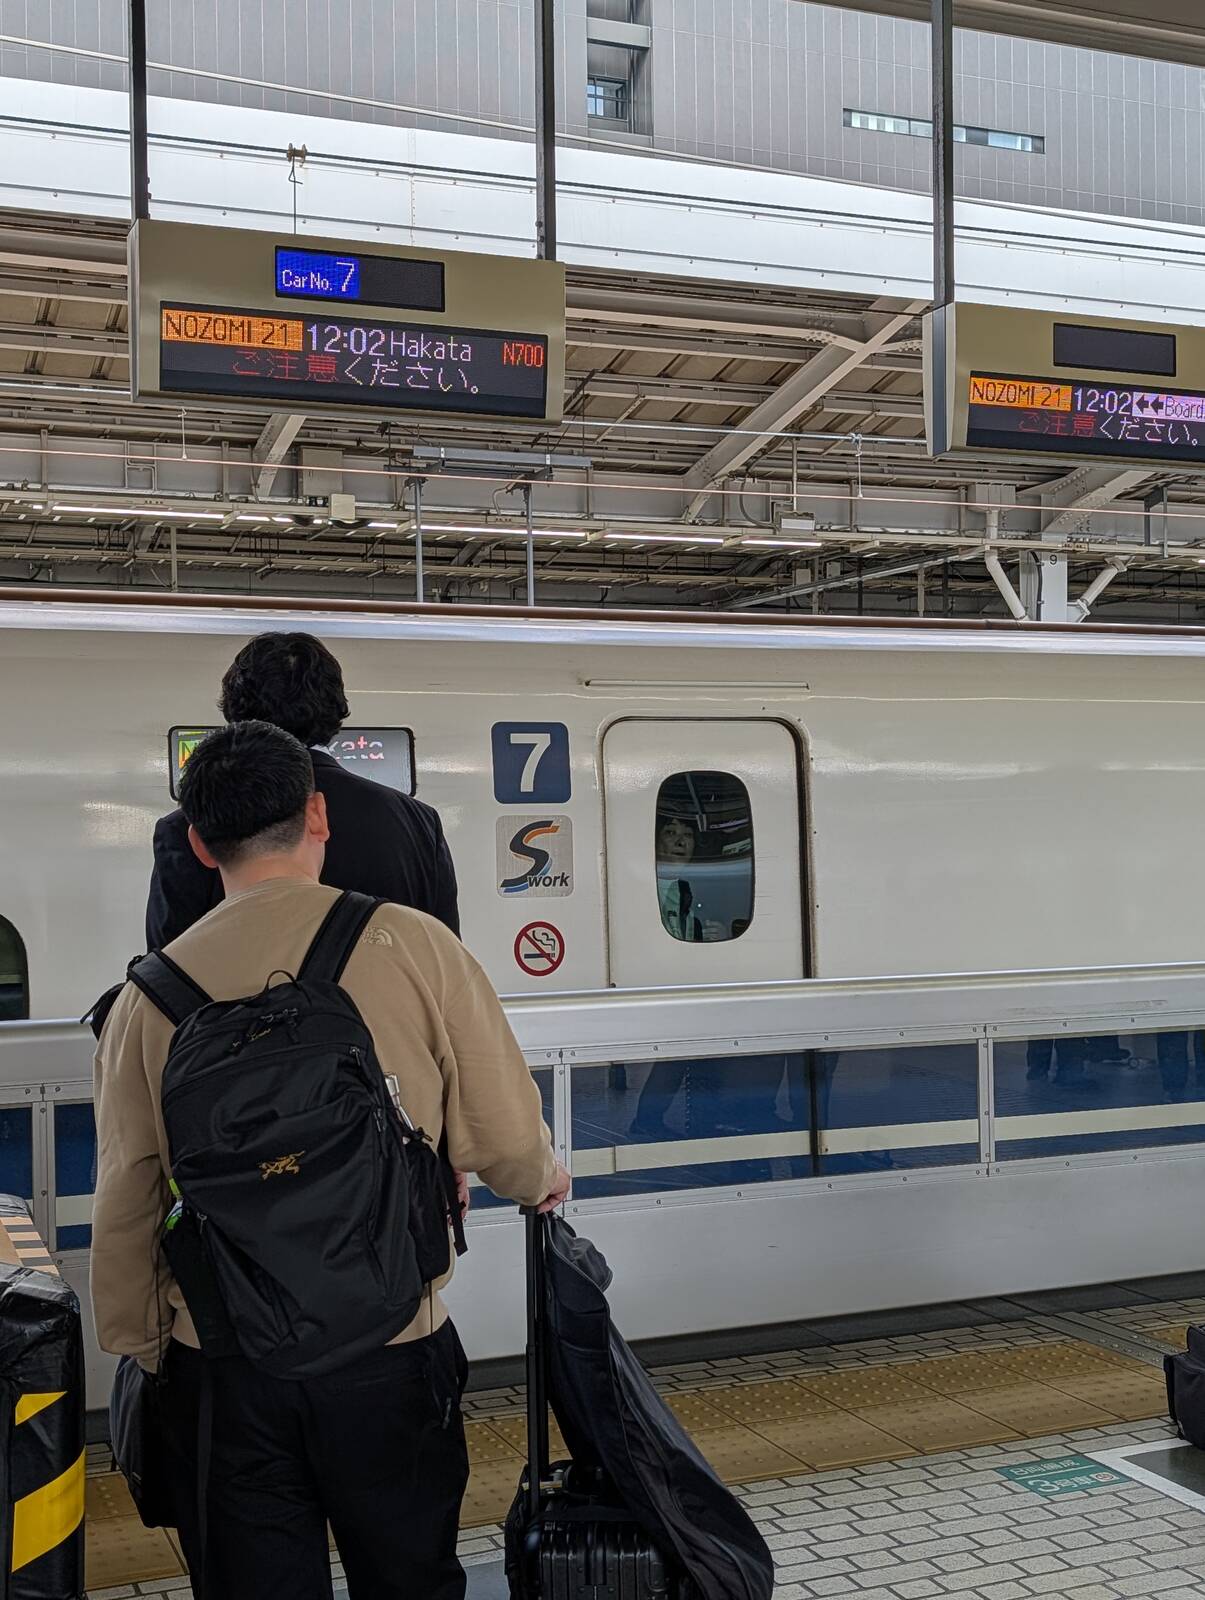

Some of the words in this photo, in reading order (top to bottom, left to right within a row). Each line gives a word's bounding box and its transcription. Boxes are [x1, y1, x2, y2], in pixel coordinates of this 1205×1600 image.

[336, 261, 355, 292] 7
[165, 312, 252, 344] NOZOMI
[261, 321, 288, 346] 21
[306, 324, 385, 356] 12:02
[390, 330, 472, 361] Hakata
[503, 341, 544, 368] N700
[231, 349, 479, 394] ご注意ください。
[972, 380, 1036, 406] NOZOMI
[1041, 386, 1061, 407] 21
[1074, 387, 1132, 415] 12:02
[1018, 409, 1198, 446] ご注意ください。
[1049, 554, 1059, 566] 9
[510, 732, 551, 793] 7
